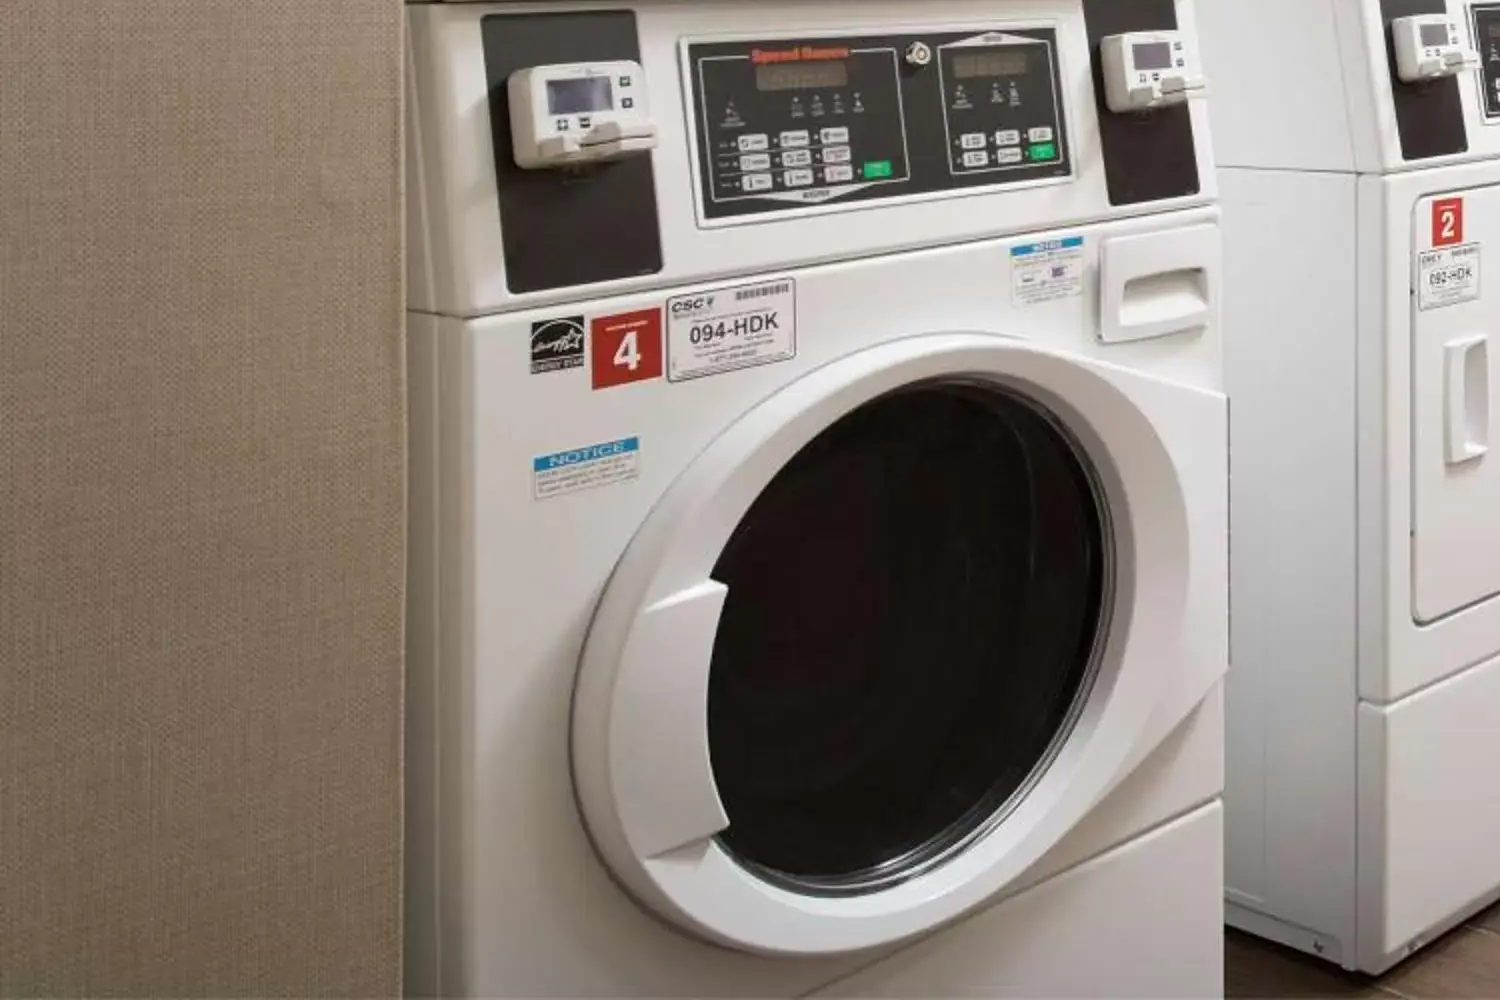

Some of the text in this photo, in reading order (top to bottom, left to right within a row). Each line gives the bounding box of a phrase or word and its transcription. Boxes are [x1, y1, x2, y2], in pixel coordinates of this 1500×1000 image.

[1441, 210, 1456, 239] 2
[671, 298, 705, 314] CSC
[689, 311, 780, 345] 094-HDK
[613, 330, 642, 371] 4
[549, 442, 625, 467] NOTICE
